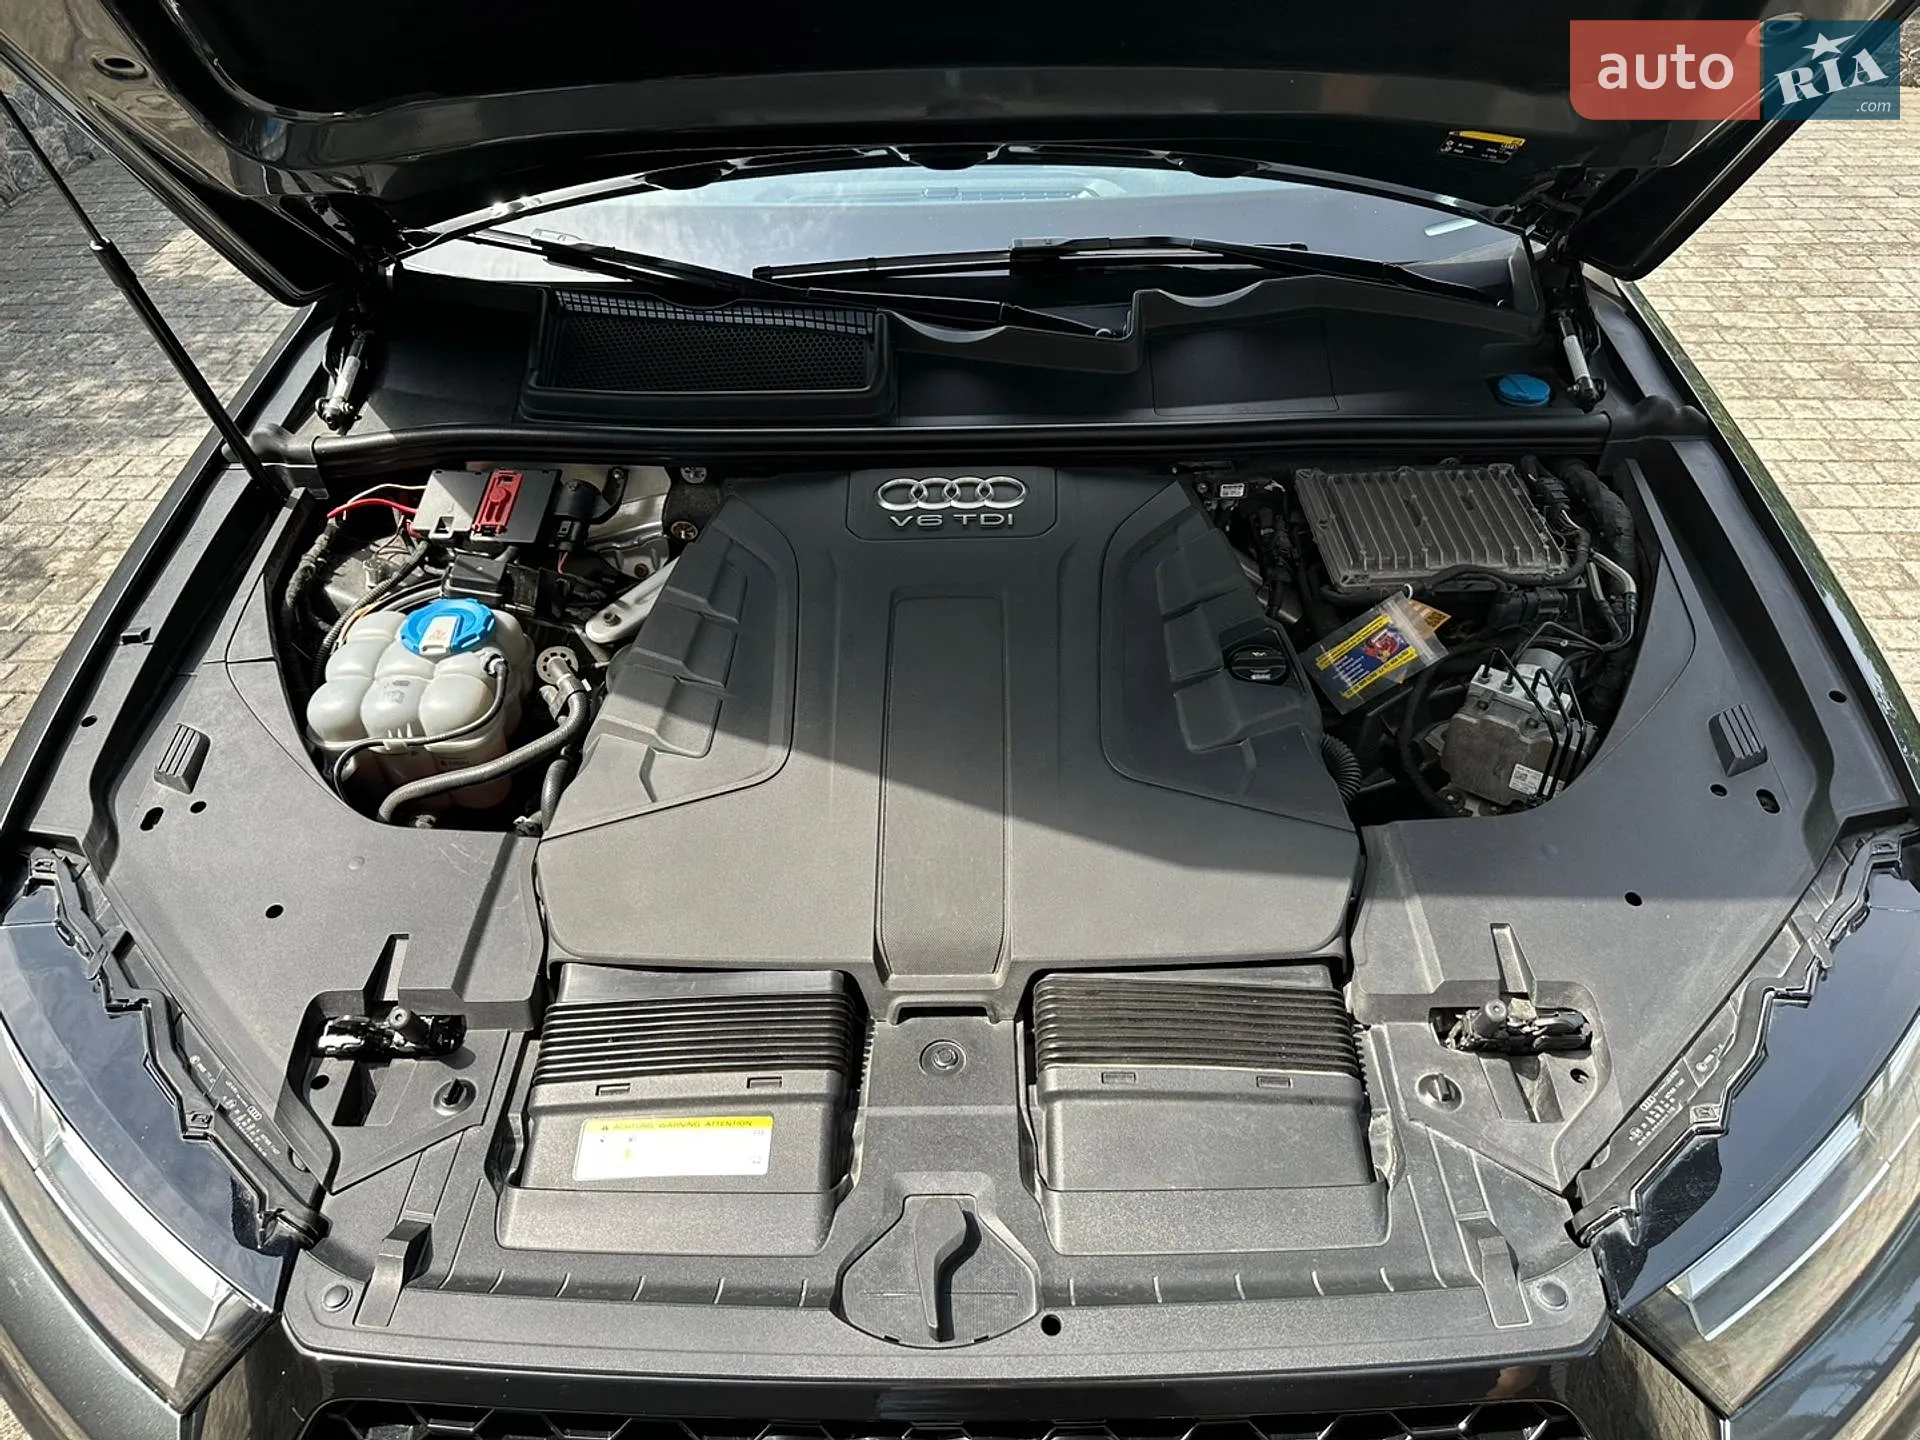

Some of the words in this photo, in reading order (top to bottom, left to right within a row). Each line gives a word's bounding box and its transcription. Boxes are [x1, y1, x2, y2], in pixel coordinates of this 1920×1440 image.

[889, 514, 943, 527] V6
[953, 513, 1013, 527] TDI
[658, 1121, 701, 1129] WARNING
[704, 1119, 753, 1128] ATTENTION
